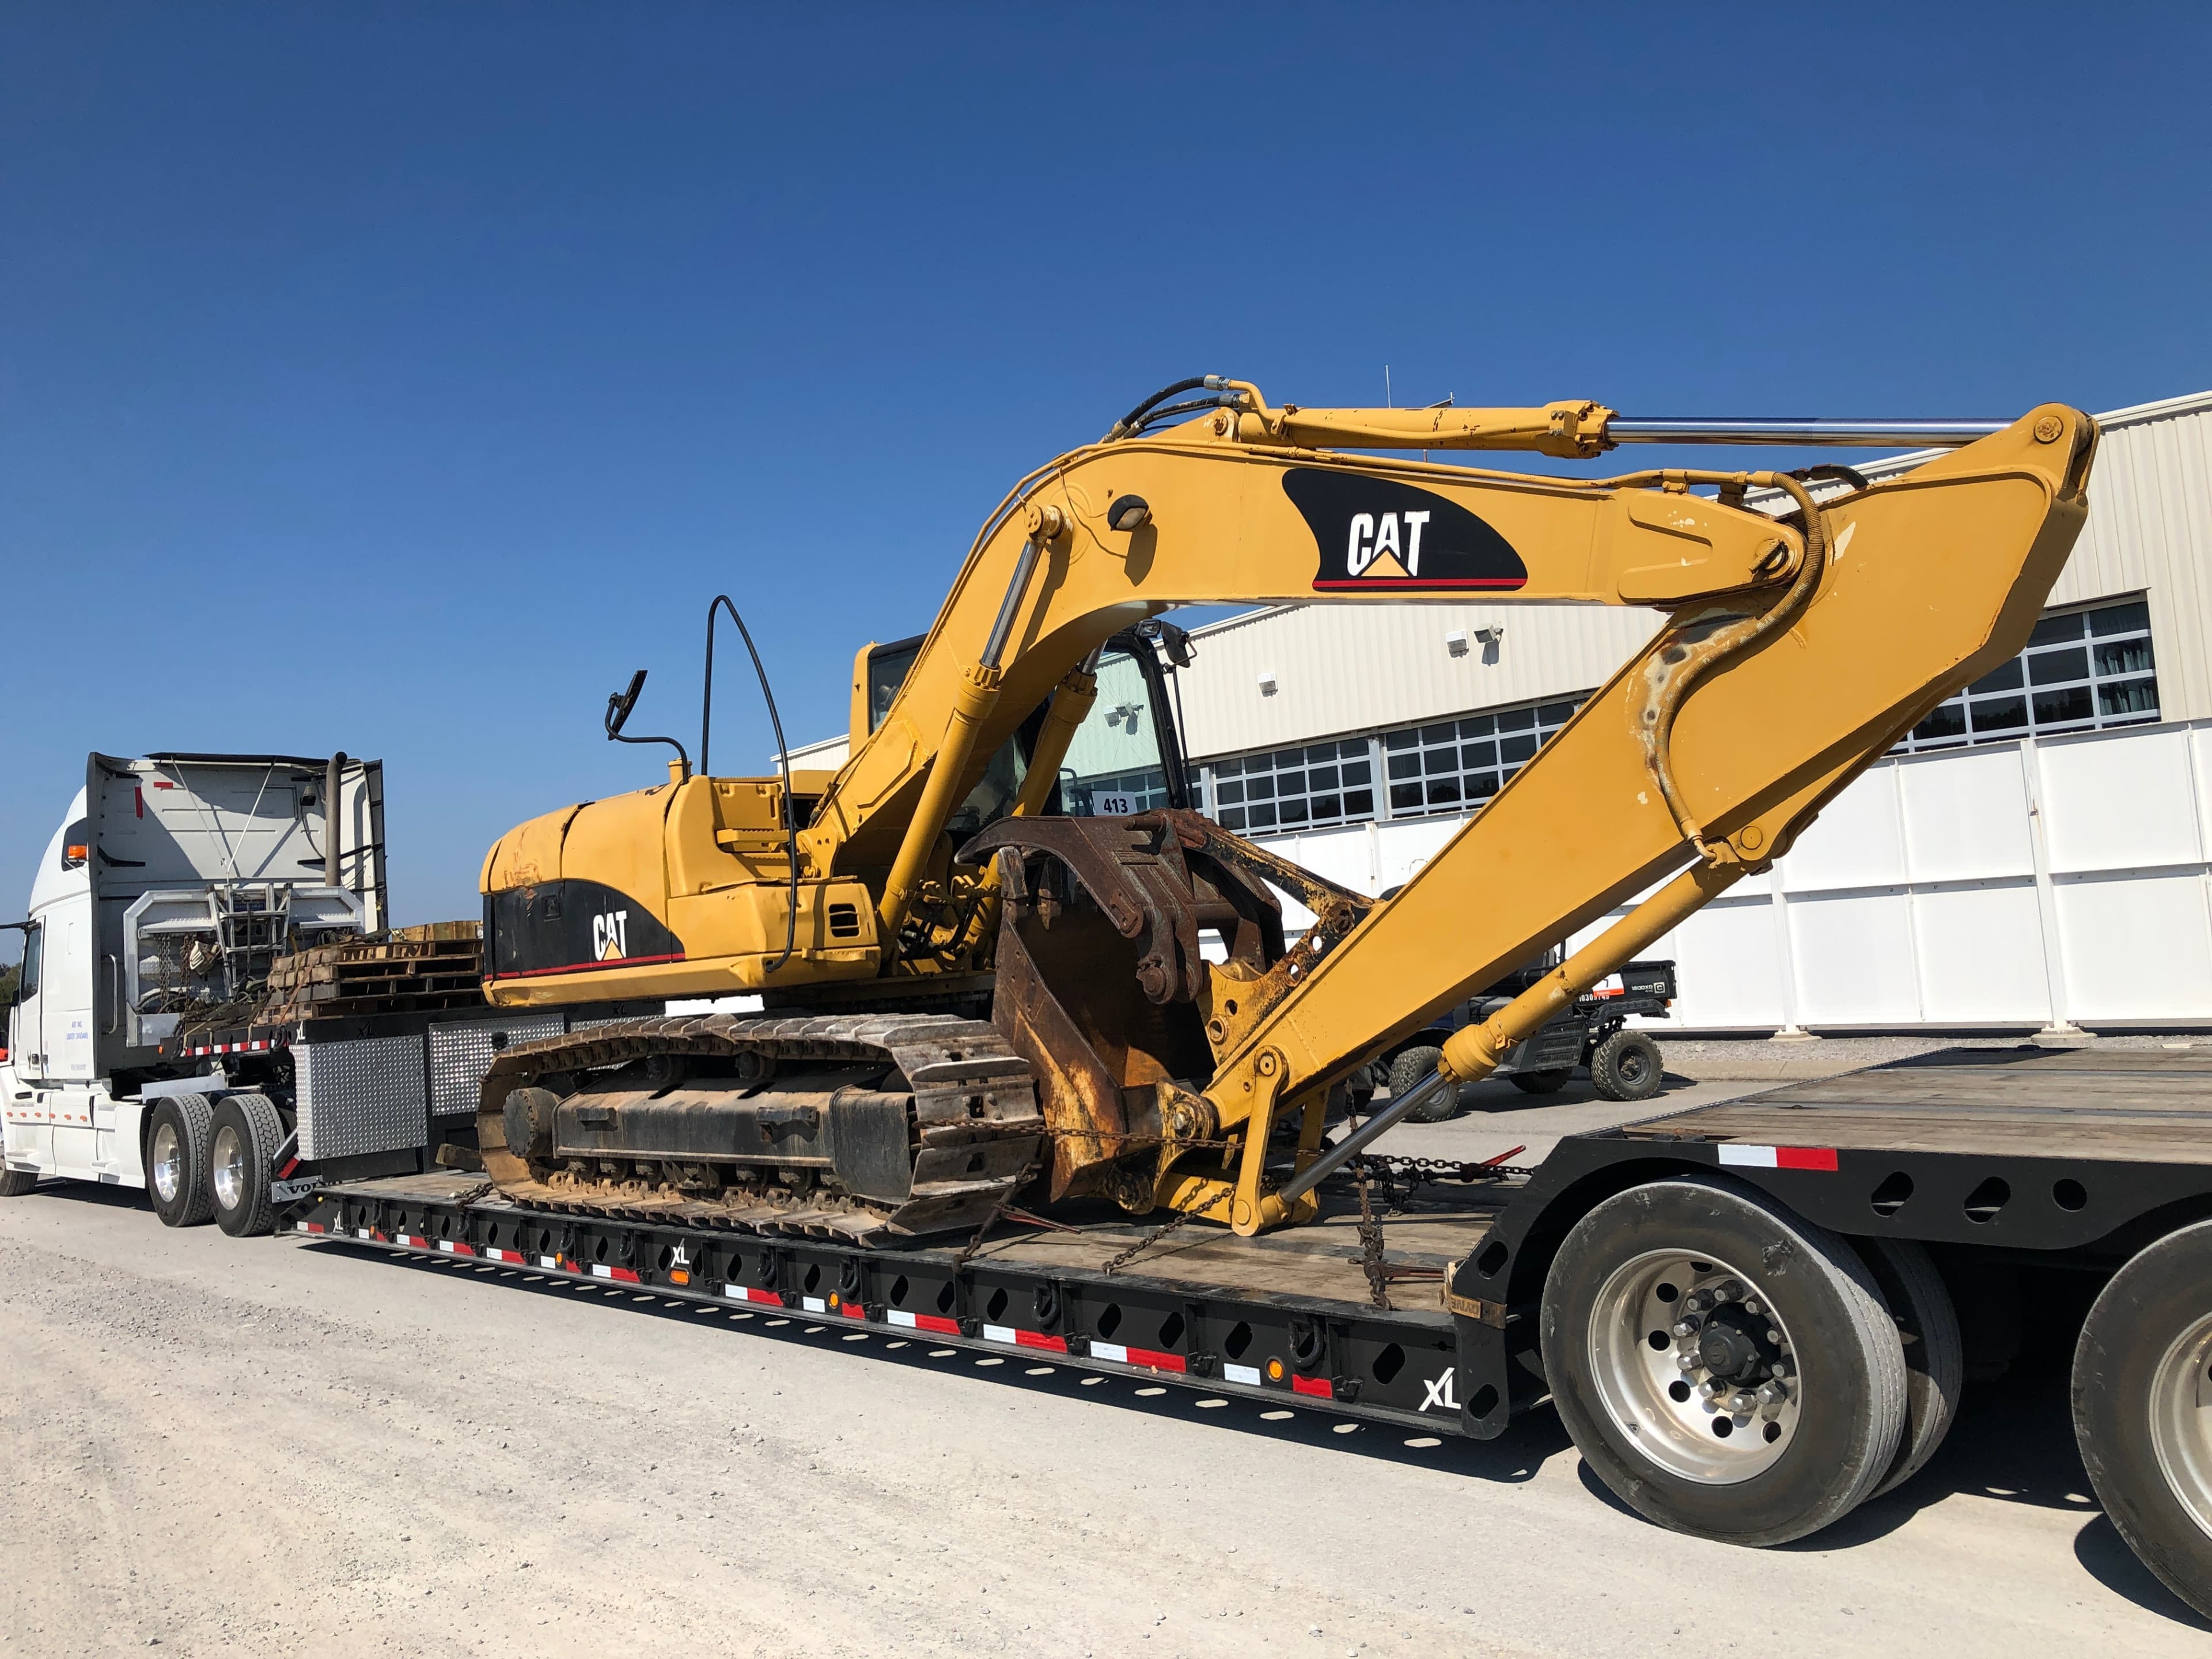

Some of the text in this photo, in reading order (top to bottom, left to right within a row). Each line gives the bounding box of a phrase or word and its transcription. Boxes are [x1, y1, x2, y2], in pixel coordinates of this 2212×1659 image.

[1347, 510, 1430, 577] CAT
[1104, 798, 1128, 813] 413
[593, 910, 627, 961] CAT
[296, 1021, 305, 1044] XL
[333, 1211, 343, 1233] XL
[671, 1238, 690, 1268] XL
[1418, 1367, 1461, 1411] XL
